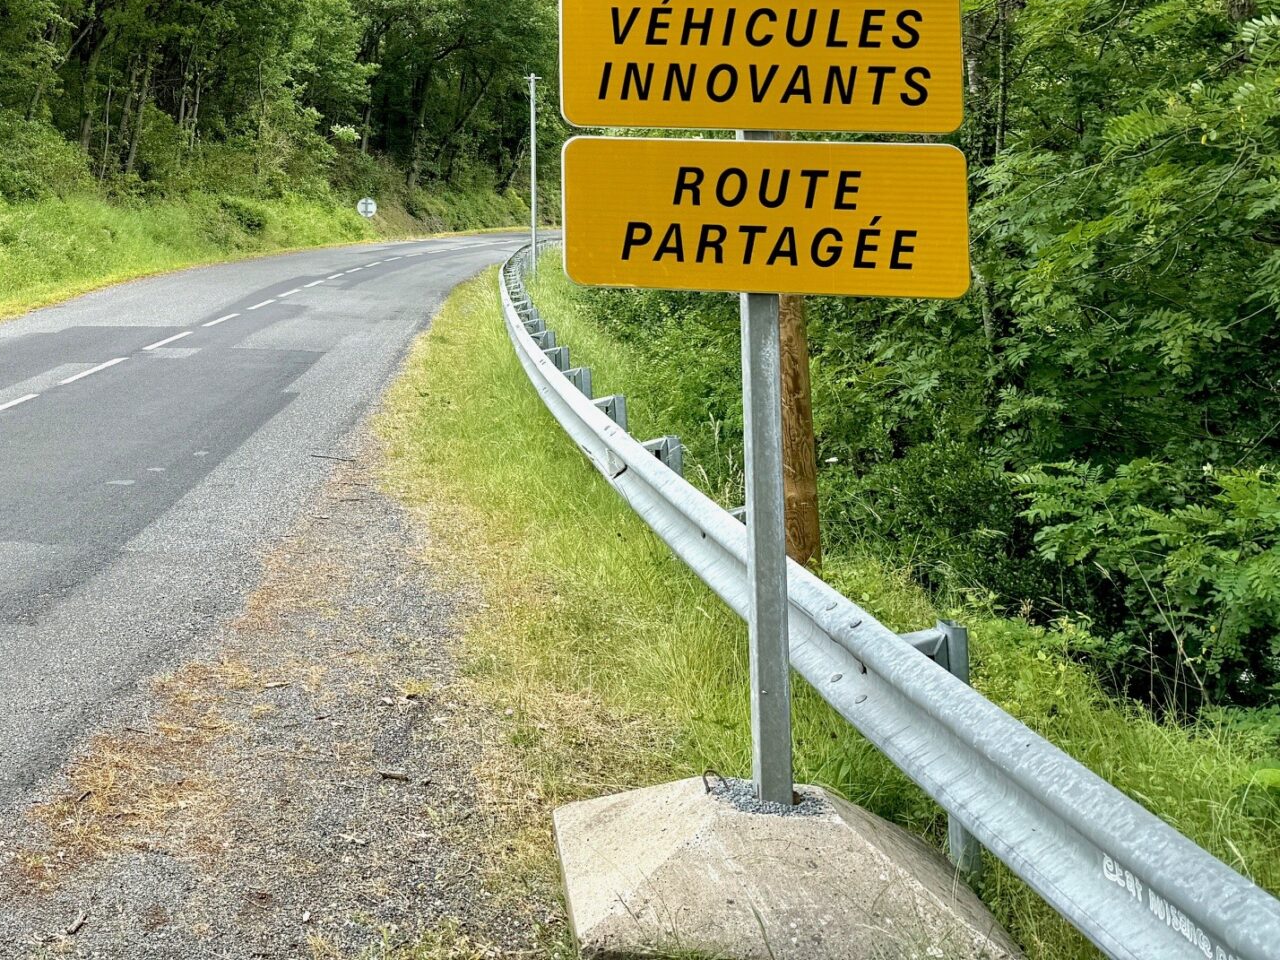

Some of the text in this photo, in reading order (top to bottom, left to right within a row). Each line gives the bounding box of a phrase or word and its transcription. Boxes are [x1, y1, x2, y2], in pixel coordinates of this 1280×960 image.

[599, 63, 930, 106] INNOVANTS
[673, 167, 861, 210] ROUTE
[622, 216, 916, 269] PARTAGÉE
